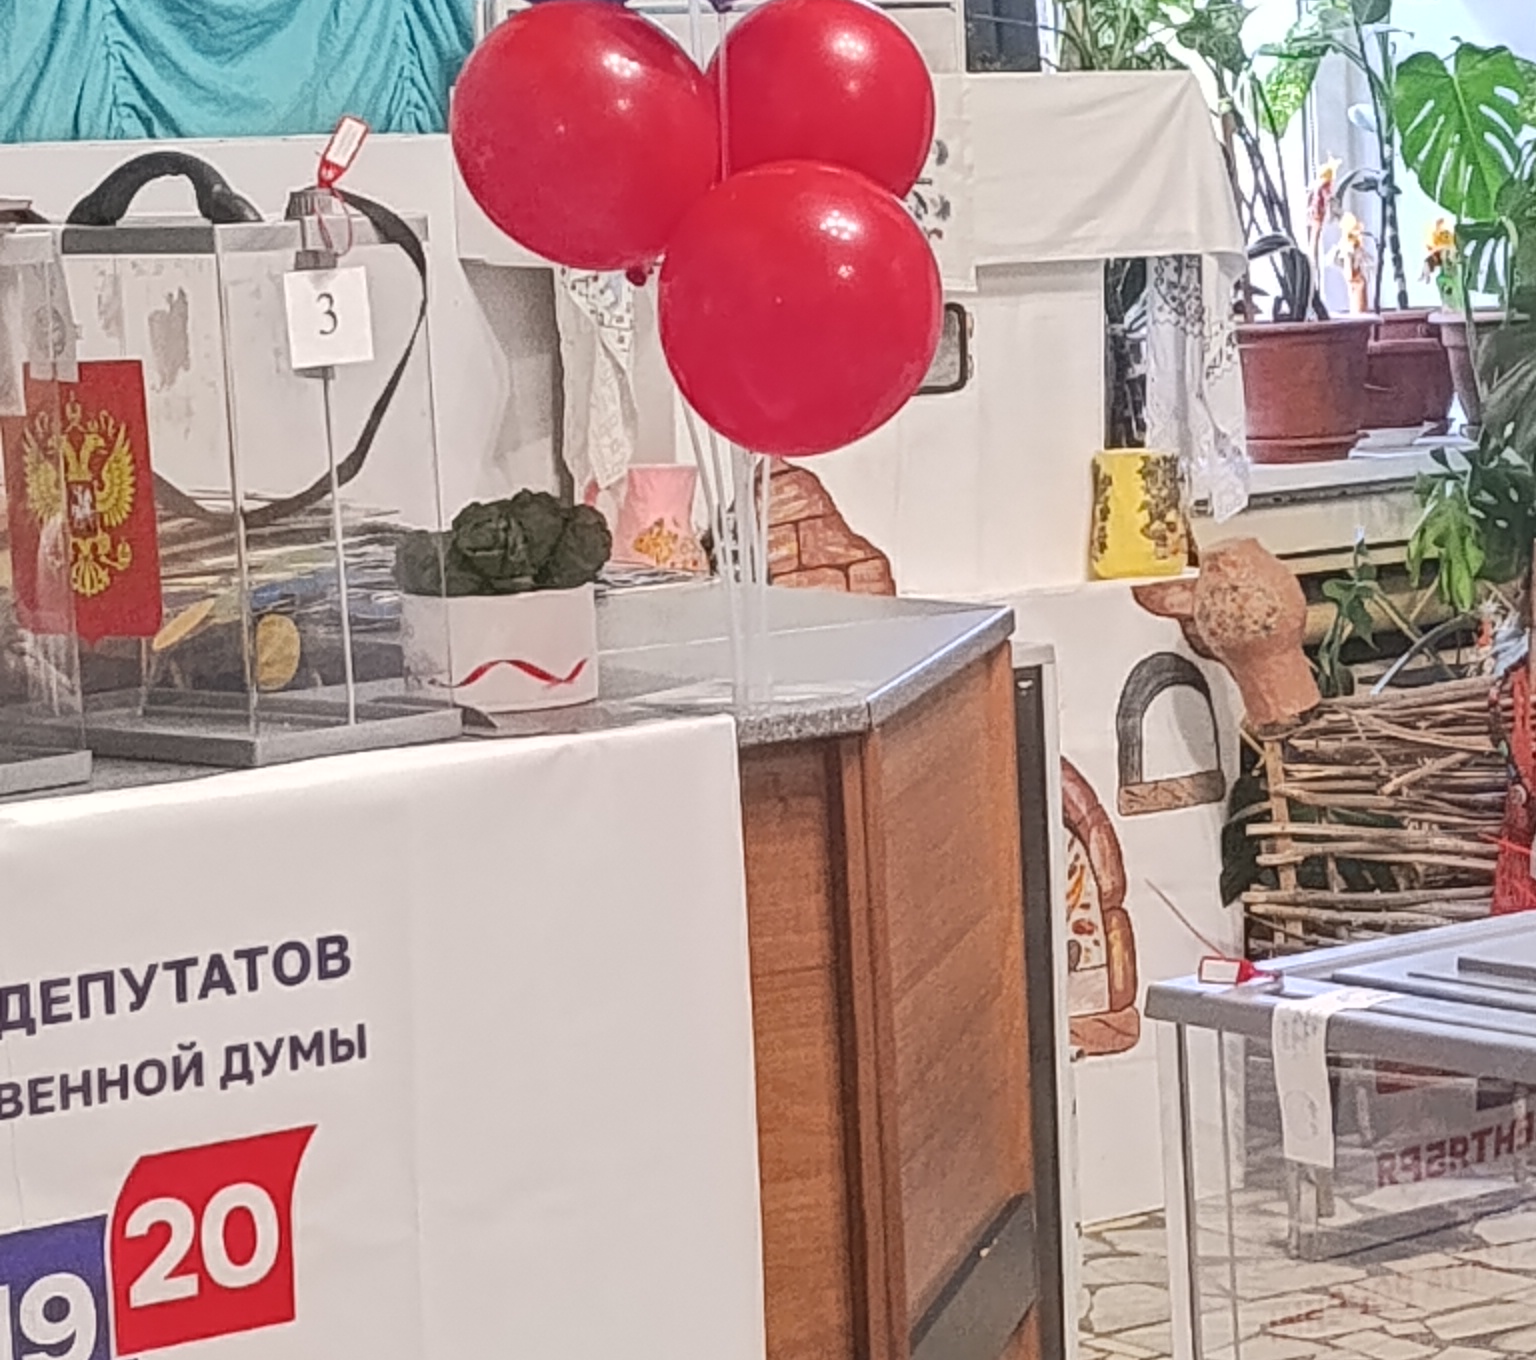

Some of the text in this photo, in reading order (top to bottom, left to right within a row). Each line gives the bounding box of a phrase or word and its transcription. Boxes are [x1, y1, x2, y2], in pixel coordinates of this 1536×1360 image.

[316, 292, 339, 335] 3
[0, 935, 352, 1038] ДЕПУТАТОВ
[219, 1023, 367, 1091] ДУМЫ
[124, 1182, 280, 1310] 20
